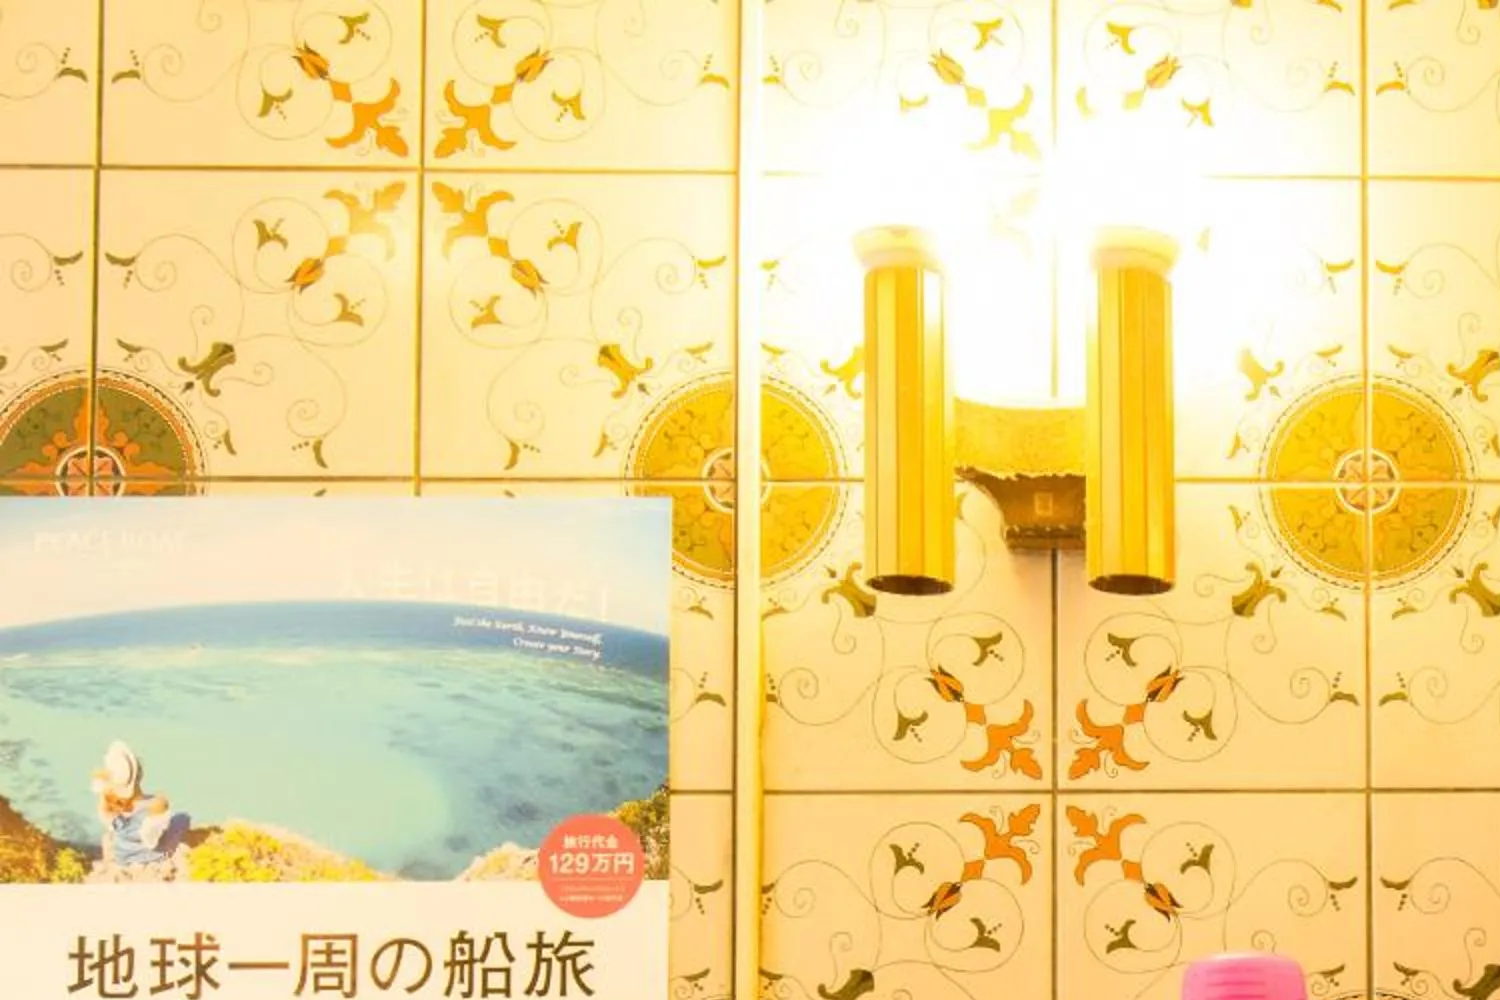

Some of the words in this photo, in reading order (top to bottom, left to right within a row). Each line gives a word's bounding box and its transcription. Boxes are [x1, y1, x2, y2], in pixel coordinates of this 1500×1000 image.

[549, 852, 635, 875] 129万円
[66, 929, 596, 1000] 地球一周の船旅
